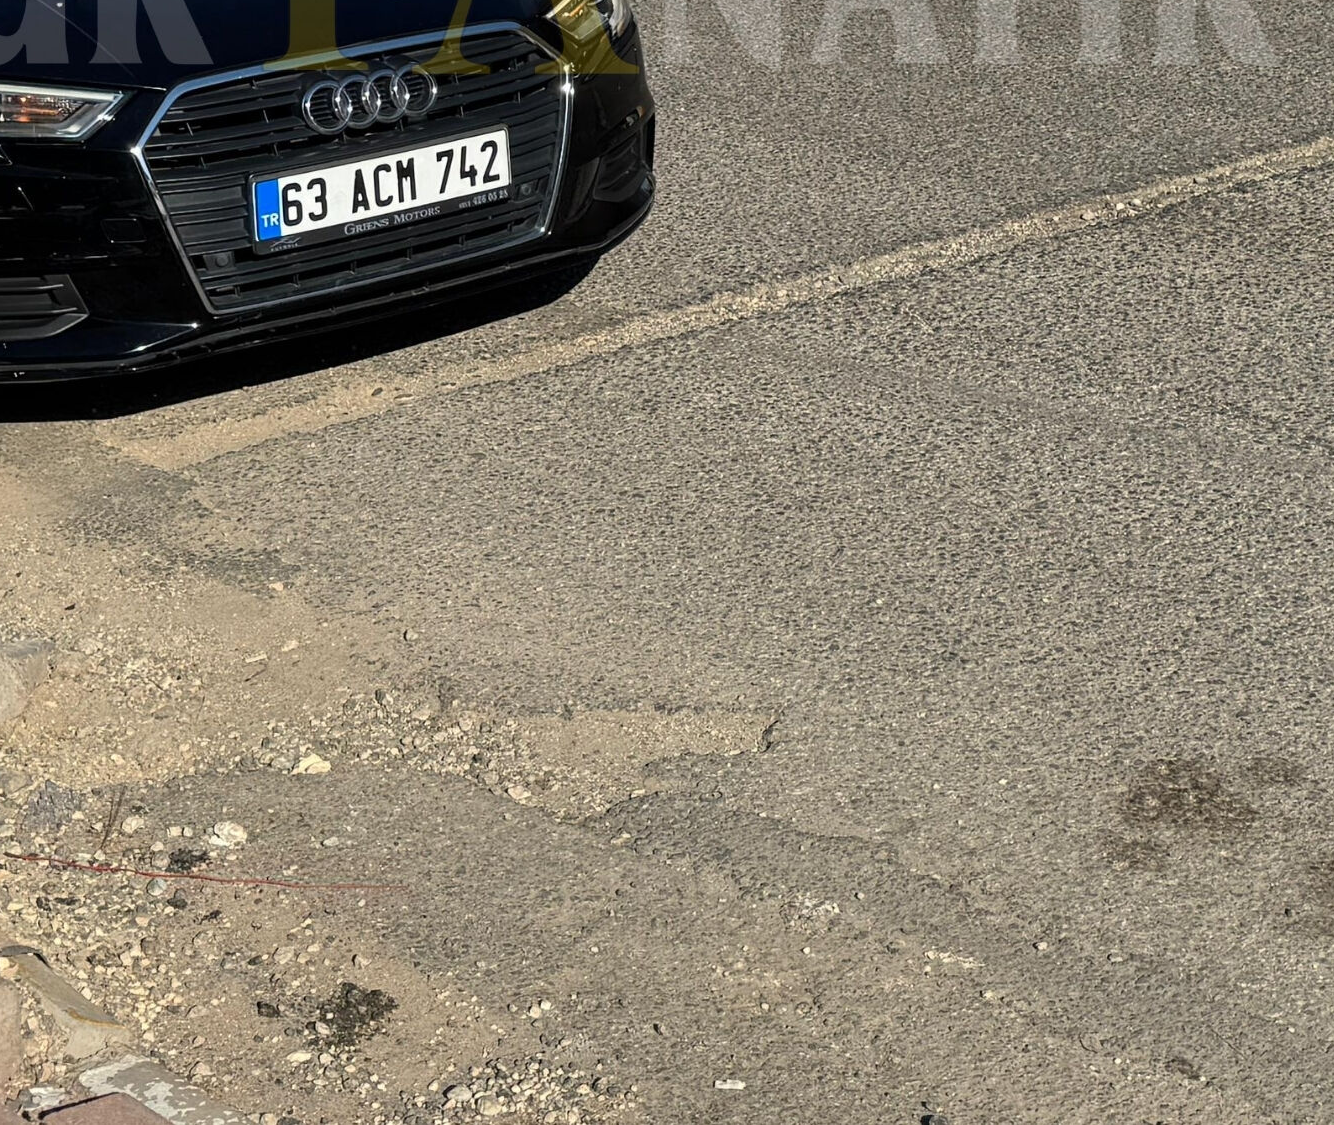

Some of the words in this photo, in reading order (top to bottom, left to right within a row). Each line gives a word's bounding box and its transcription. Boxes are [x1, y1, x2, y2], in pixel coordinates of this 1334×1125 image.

[261, 212, 280, 228] TR
[281, 177, 328, 226] 63
[352, 158, 417, 213] ACM
[436, 140, 501, 195] 742
[393, 206, 441, 225] MOTORS
